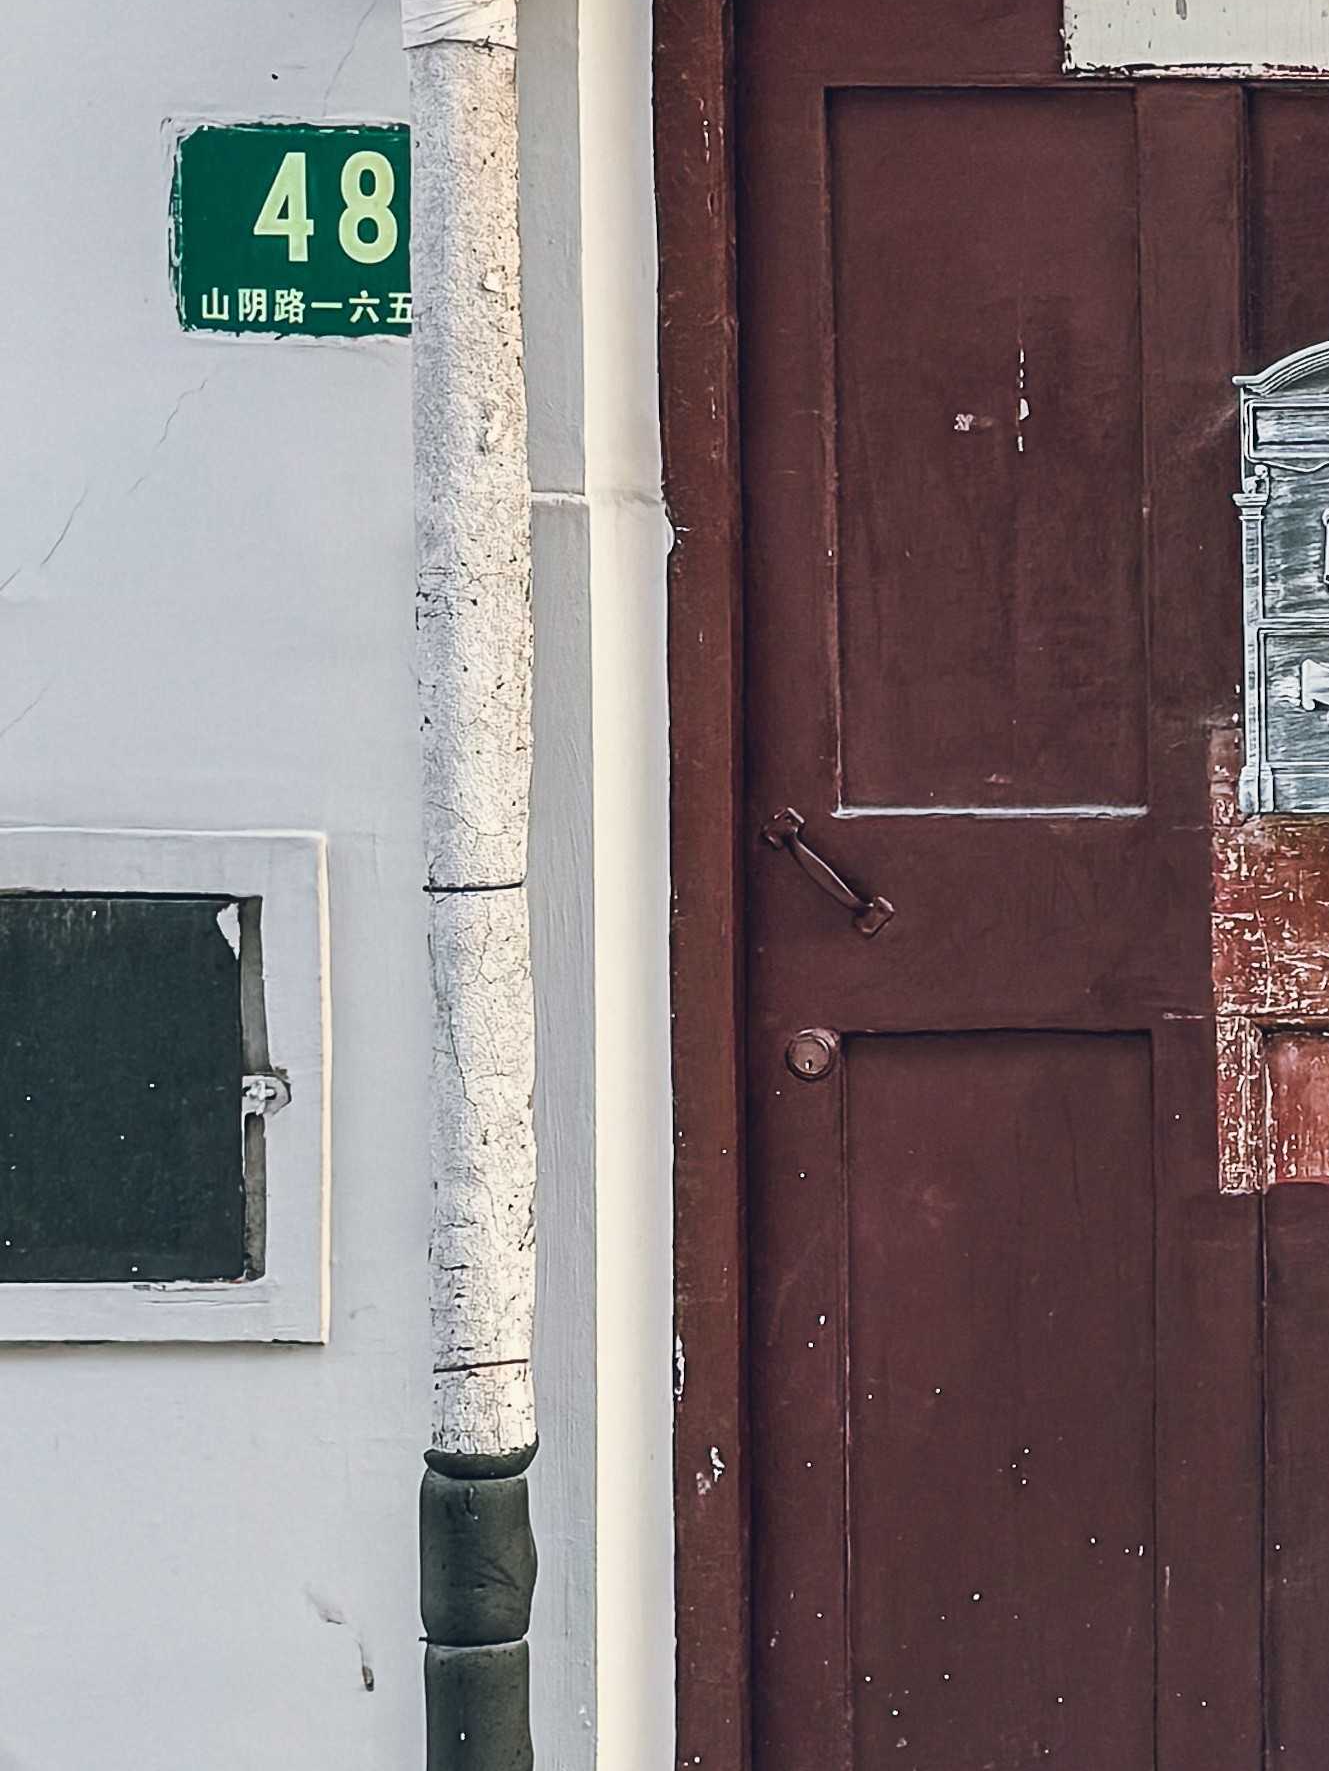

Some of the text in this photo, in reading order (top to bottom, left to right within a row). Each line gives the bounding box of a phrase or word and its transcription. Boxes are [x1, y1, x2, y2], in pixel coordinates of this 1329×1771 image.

[253, 150, 398, 264] 48
[201, 286, 413, 324] 山阴路一六五
